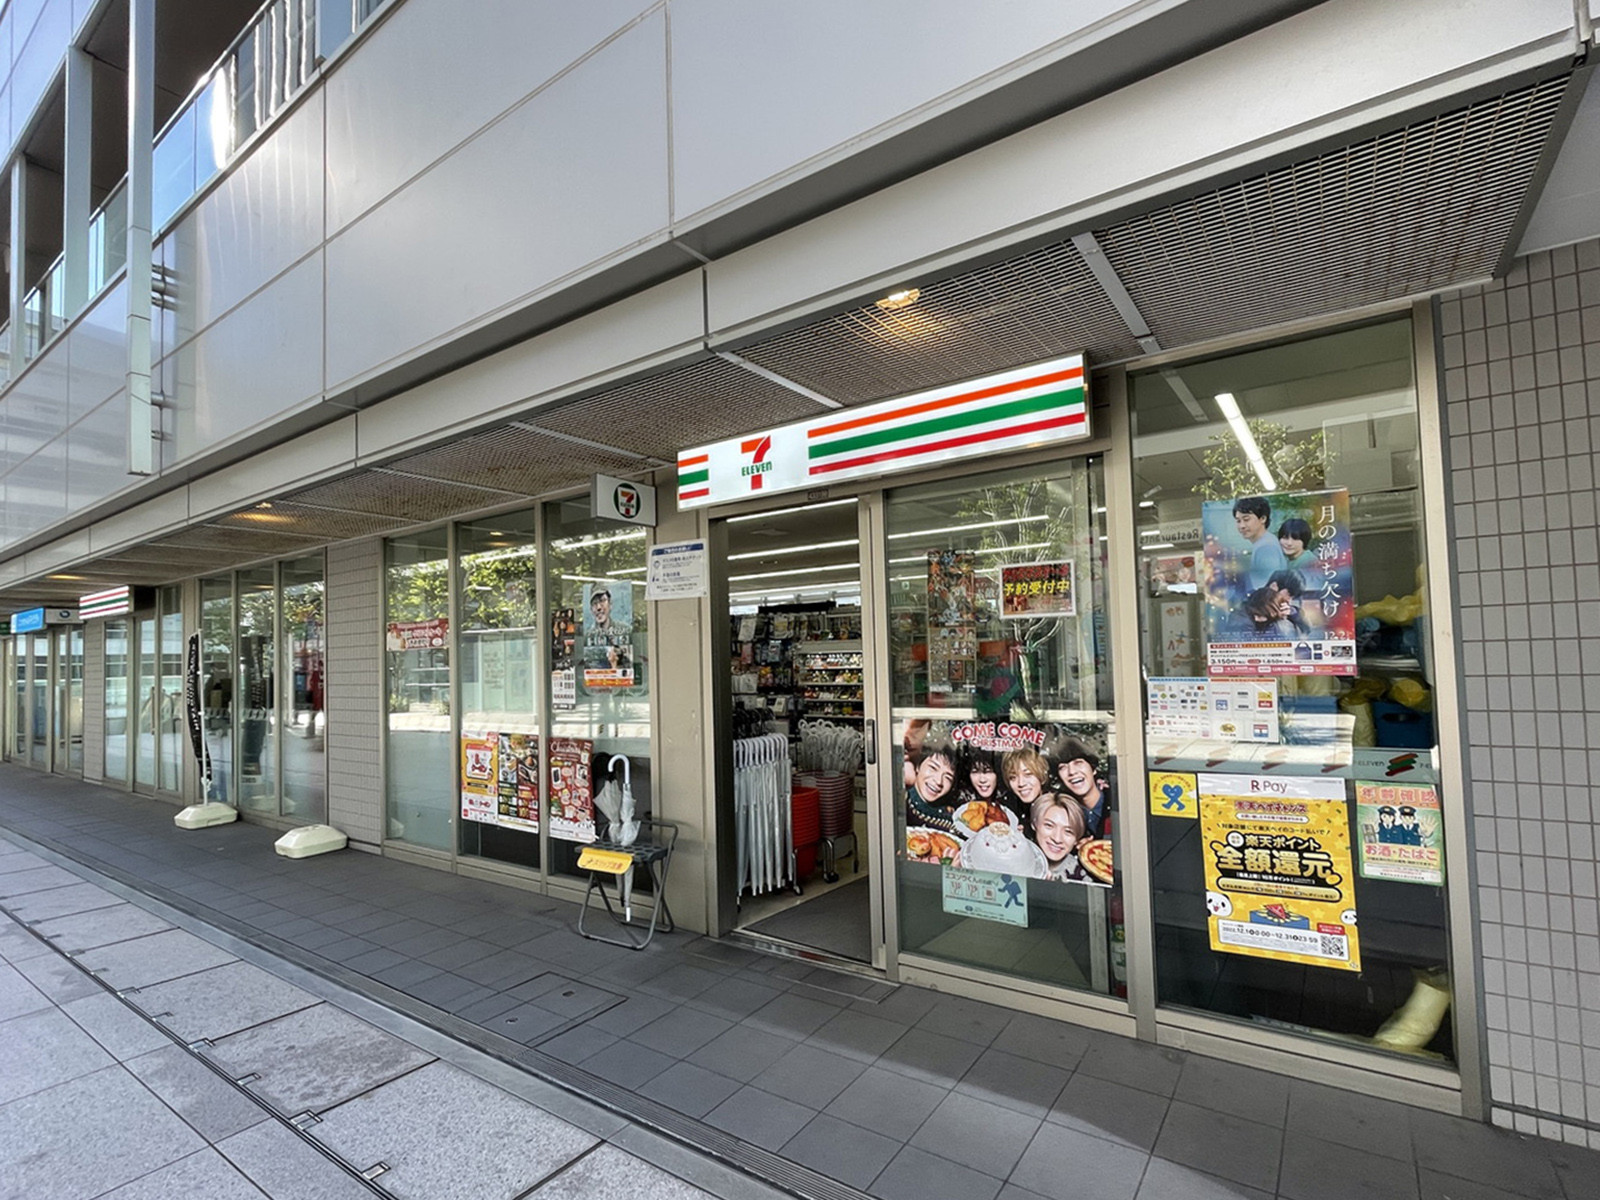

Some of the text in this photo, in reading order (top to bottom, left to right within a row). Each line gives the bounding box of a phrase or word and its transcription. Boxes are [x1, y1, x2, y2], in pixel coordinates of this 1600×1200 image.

[741, 435, 771, 490] 7
[1317, 504, 1341, 618] 月の満ち欠け
[1004, 578, 1070, 596] 予約受付中
[952, 721, 1046, 747] COME COME
[971, 737, 1024, 749] CHRISTMAS
[1263, 780, 1288, 794] Pay
[1245, 834, 1321, 851] 楽天ポイント
[1216, 846, 1332, 879] 全額還元
